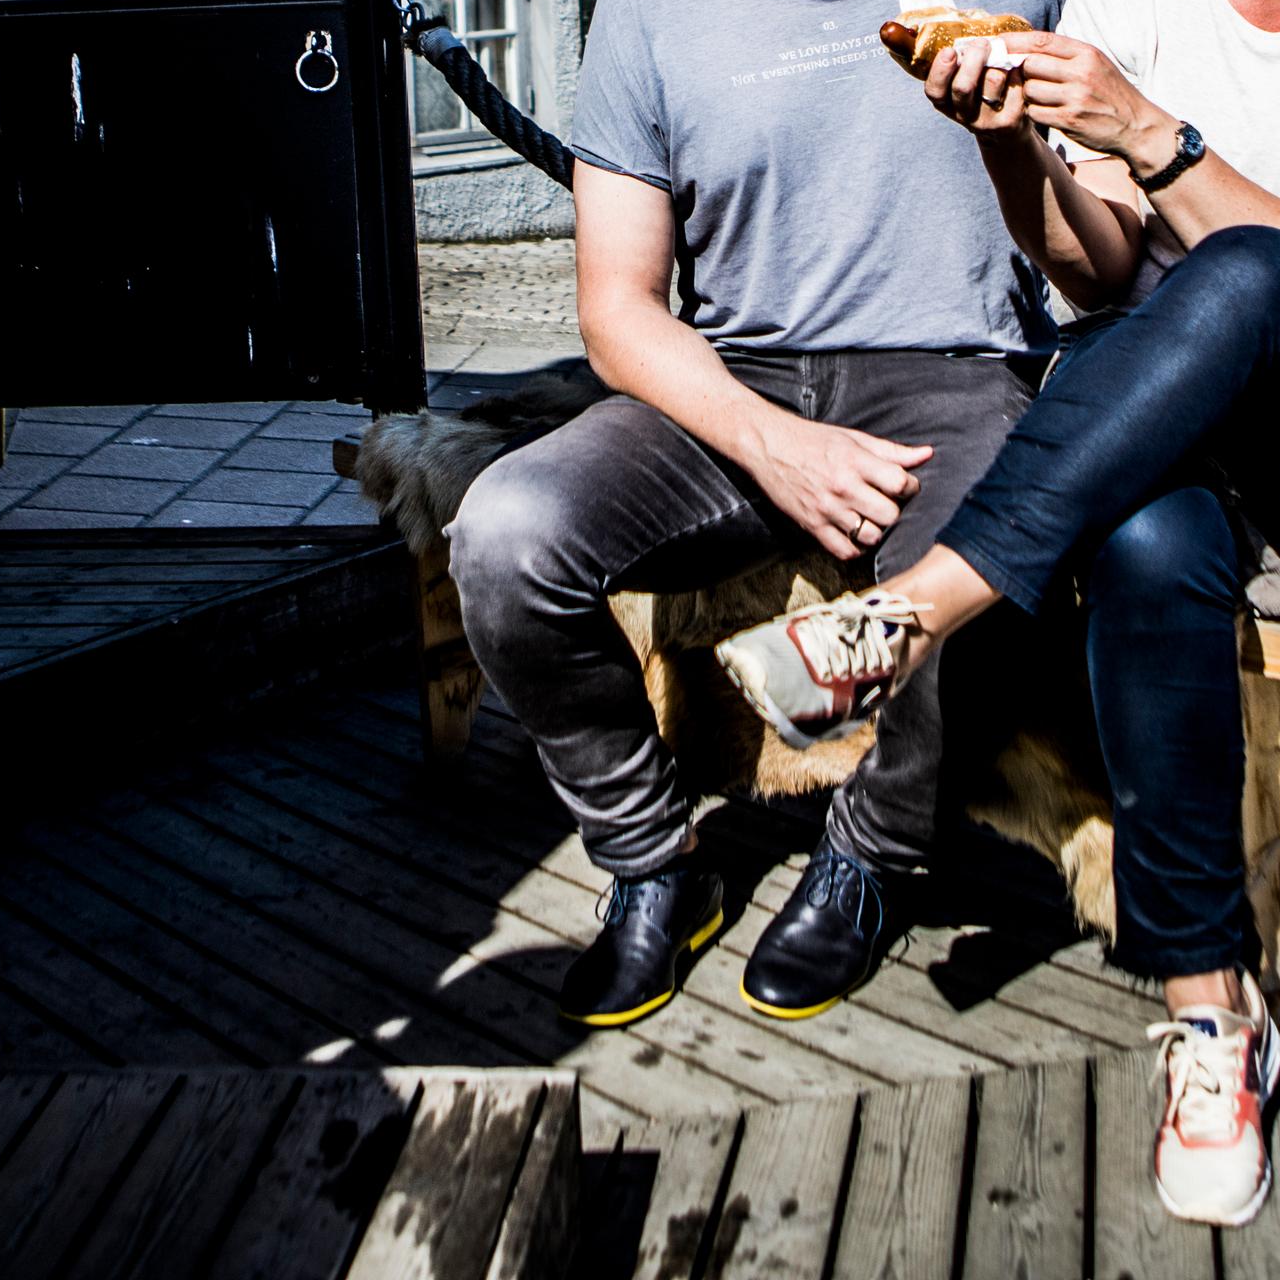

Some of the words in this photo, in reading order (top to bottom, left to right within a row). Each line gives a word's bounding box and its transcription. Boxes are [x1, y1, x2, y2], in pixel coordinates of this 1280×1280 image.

[778, 49, 798, 61] WE
[798, 44, 830, 59] LOVE
[831, 37, 862, 53] DAYS
[762, 58, 831, 80] EVERYTHING
[832, 51, 868, 65] NEEDS
[870, 47, 886, 58] TO
